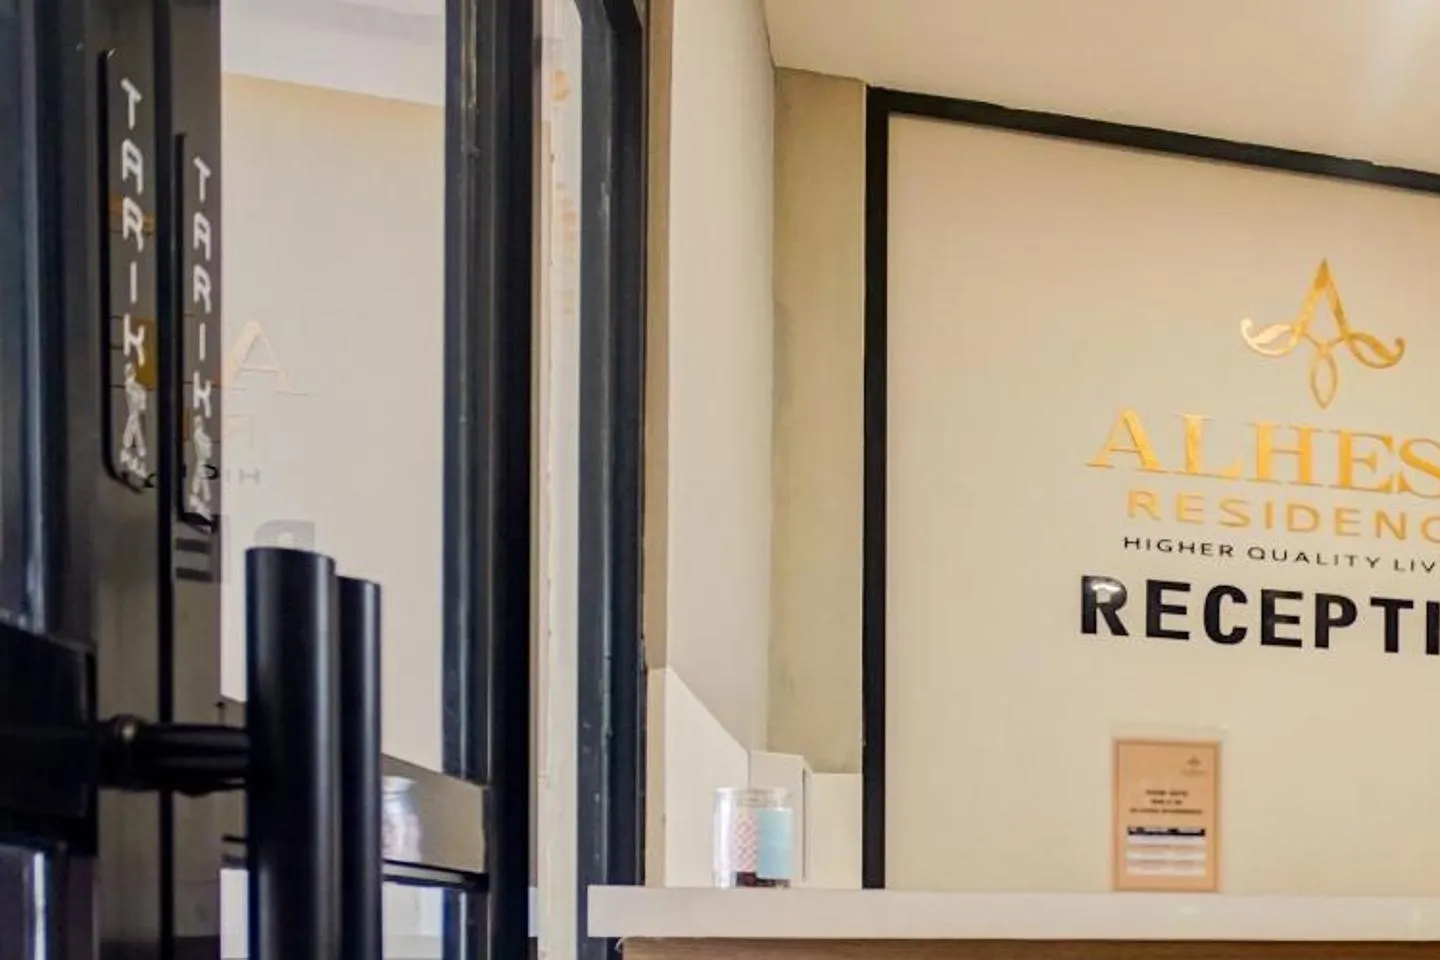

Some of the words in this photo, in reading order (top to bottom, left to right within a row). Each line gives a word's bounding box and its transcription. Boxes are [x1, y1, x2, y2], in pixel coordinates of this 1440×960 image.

[120, 77, 147, 367] TARIK
[193, 156, 212, 419] TARIK
[1124, 536, 1235, 558] HIGHER
[1247, 546, 1381, 569] QUALITY
